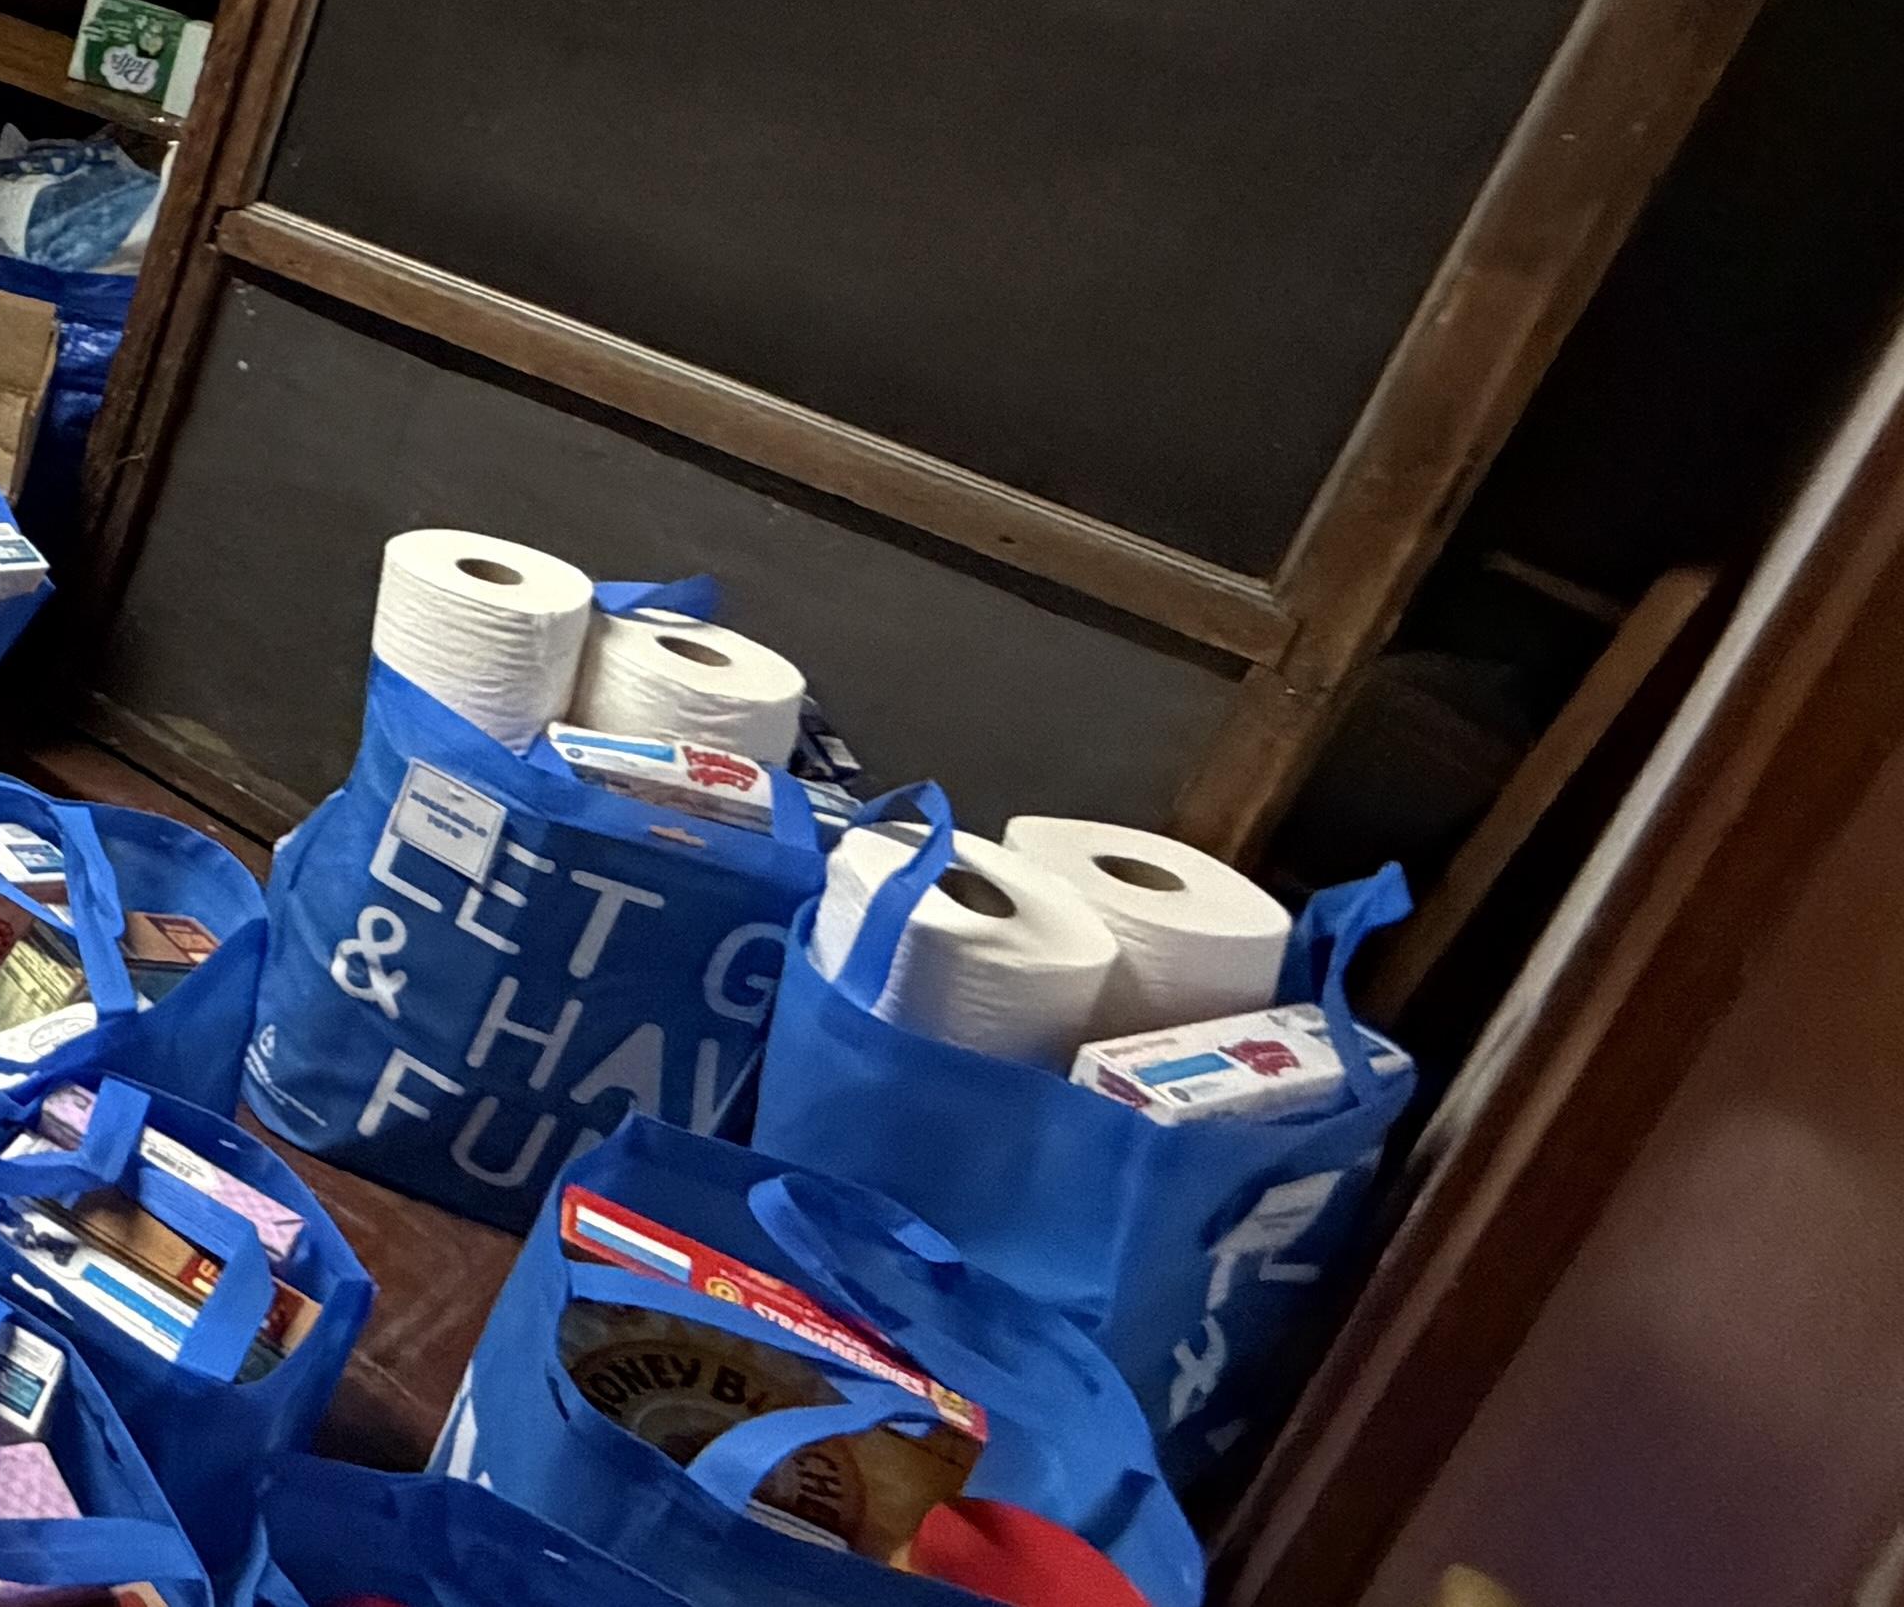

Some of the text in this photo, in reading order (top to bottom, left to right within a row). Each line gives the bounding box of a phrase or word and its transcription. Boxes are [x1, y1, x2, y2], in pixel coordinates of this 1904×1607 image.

[330, 905, 764, 1140] & HAV
[702, 921, 789, 1024] G
[356, 1048, 610, 1187] FU
